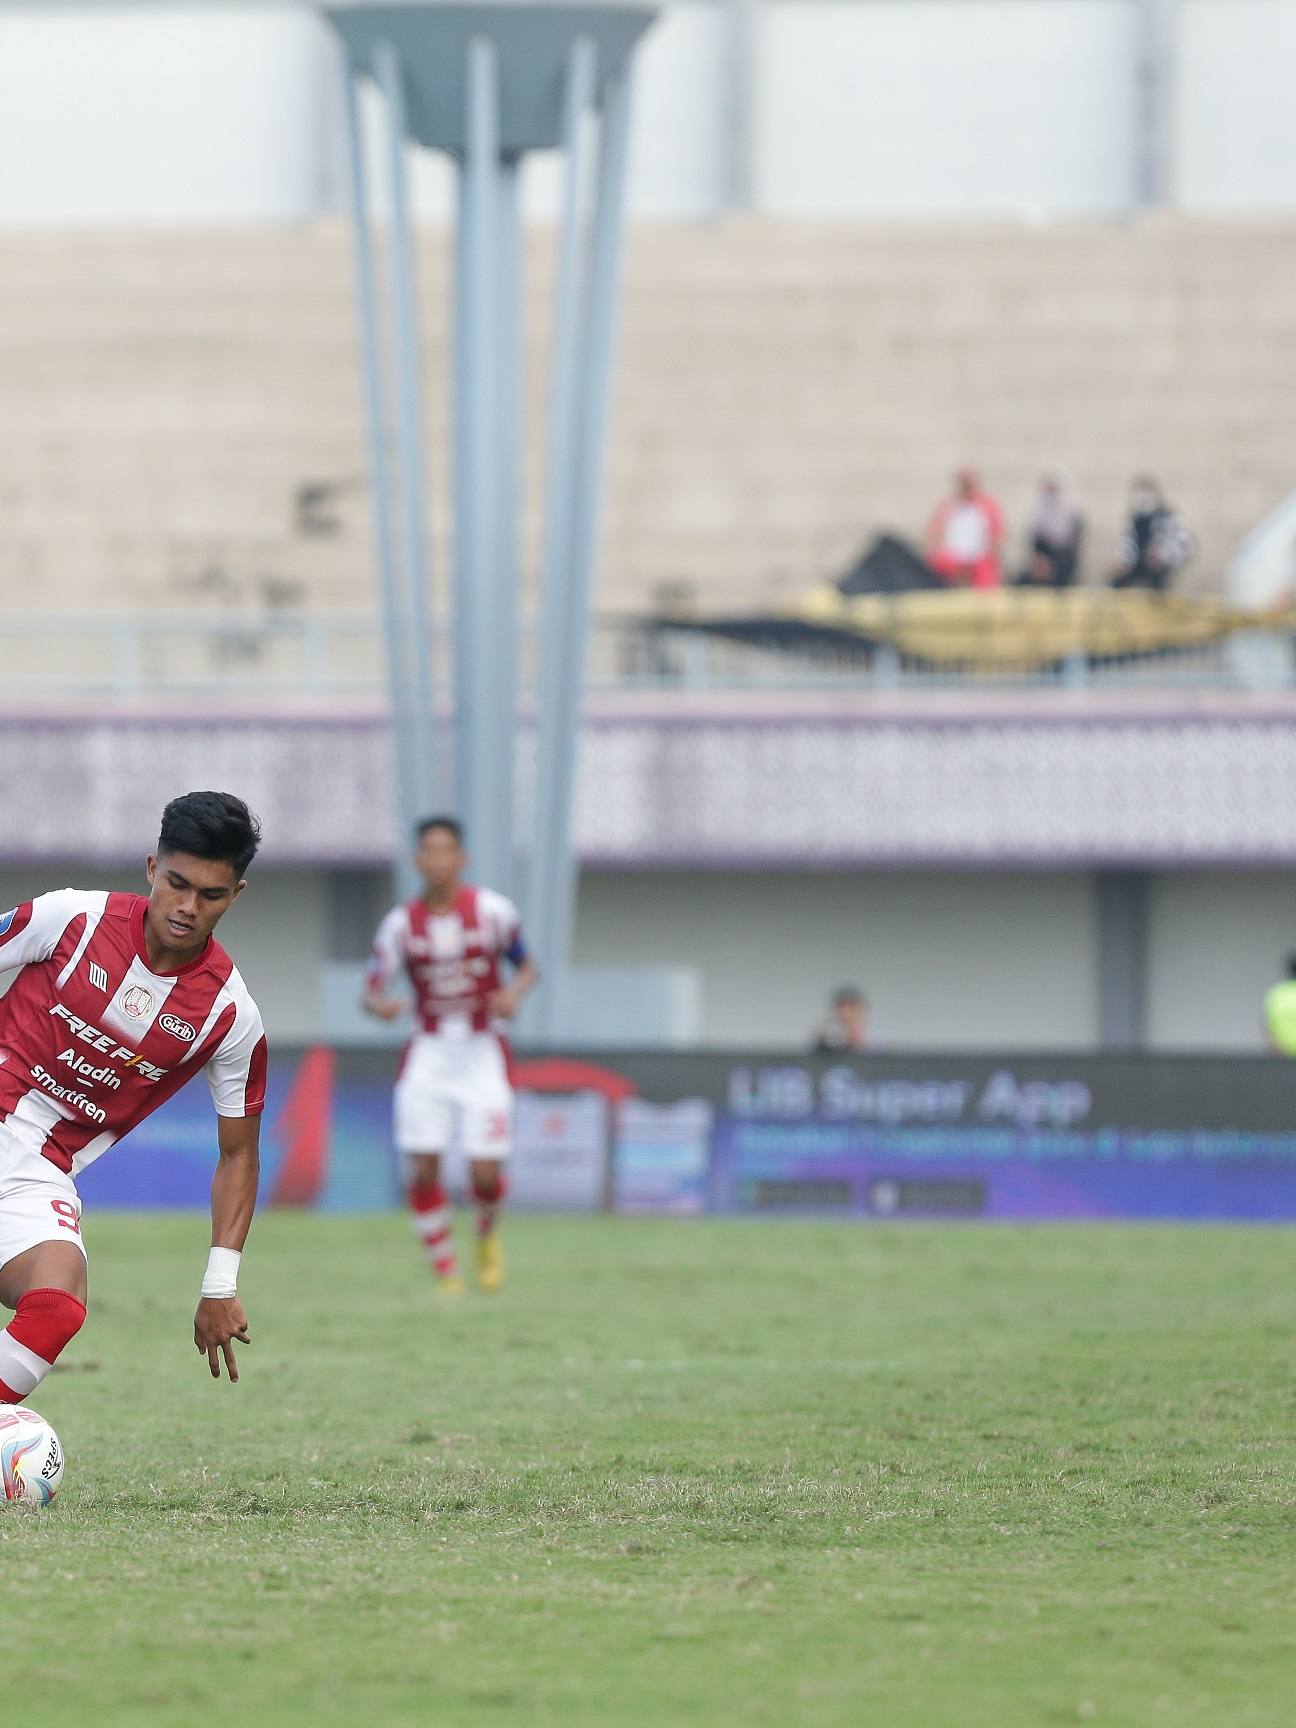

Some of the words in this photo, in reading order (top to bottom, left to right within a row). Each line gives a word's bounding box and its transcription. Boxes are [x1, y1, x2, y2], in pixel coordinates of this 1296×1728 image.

[48, 1003, 117, 1053] FREE
[109, 1047, 169, 1082] FIRE
[30, 1064, 107, 1124] smartfren
[56, 1048, 122, 1090] Aladin
[727, 1066, 815, 1117] LIB
[819, 1066, 971, 1123] Super
[979, 1069, 1093, 1124] App
[50, 1199, 80, 1235] 9
[41, 1437, 58, 1479] SPECS
